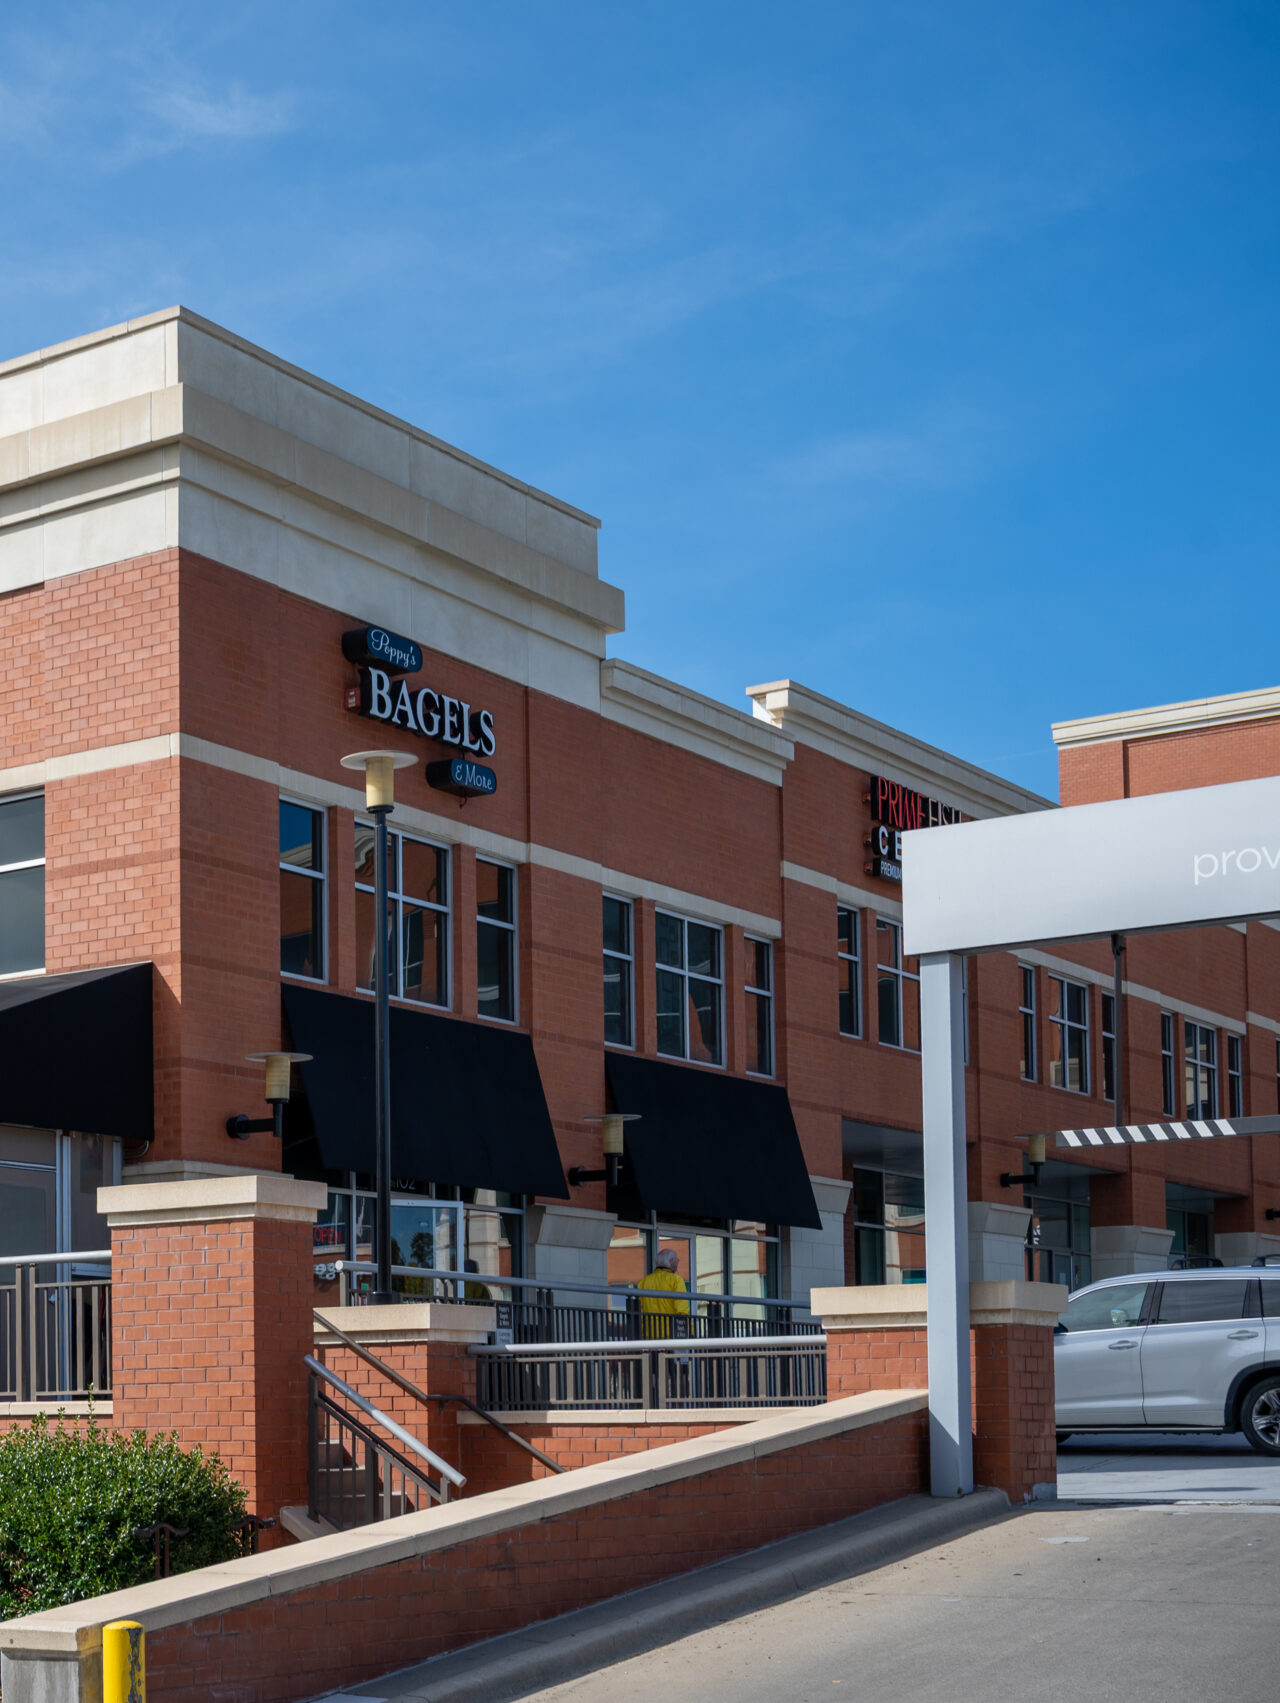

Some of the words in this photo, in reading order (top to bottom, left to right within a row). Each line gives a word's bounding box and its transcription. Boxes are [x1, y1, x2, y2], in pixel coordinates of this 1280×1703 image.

[371, 629, 416, 667] Poppy's
[369, 667, 497, 756] BAGELS
[465, 764, 493, 790] More
[1194, 846, 1280, 886] prov
[314, 1226, 342, 1244] OPEN
